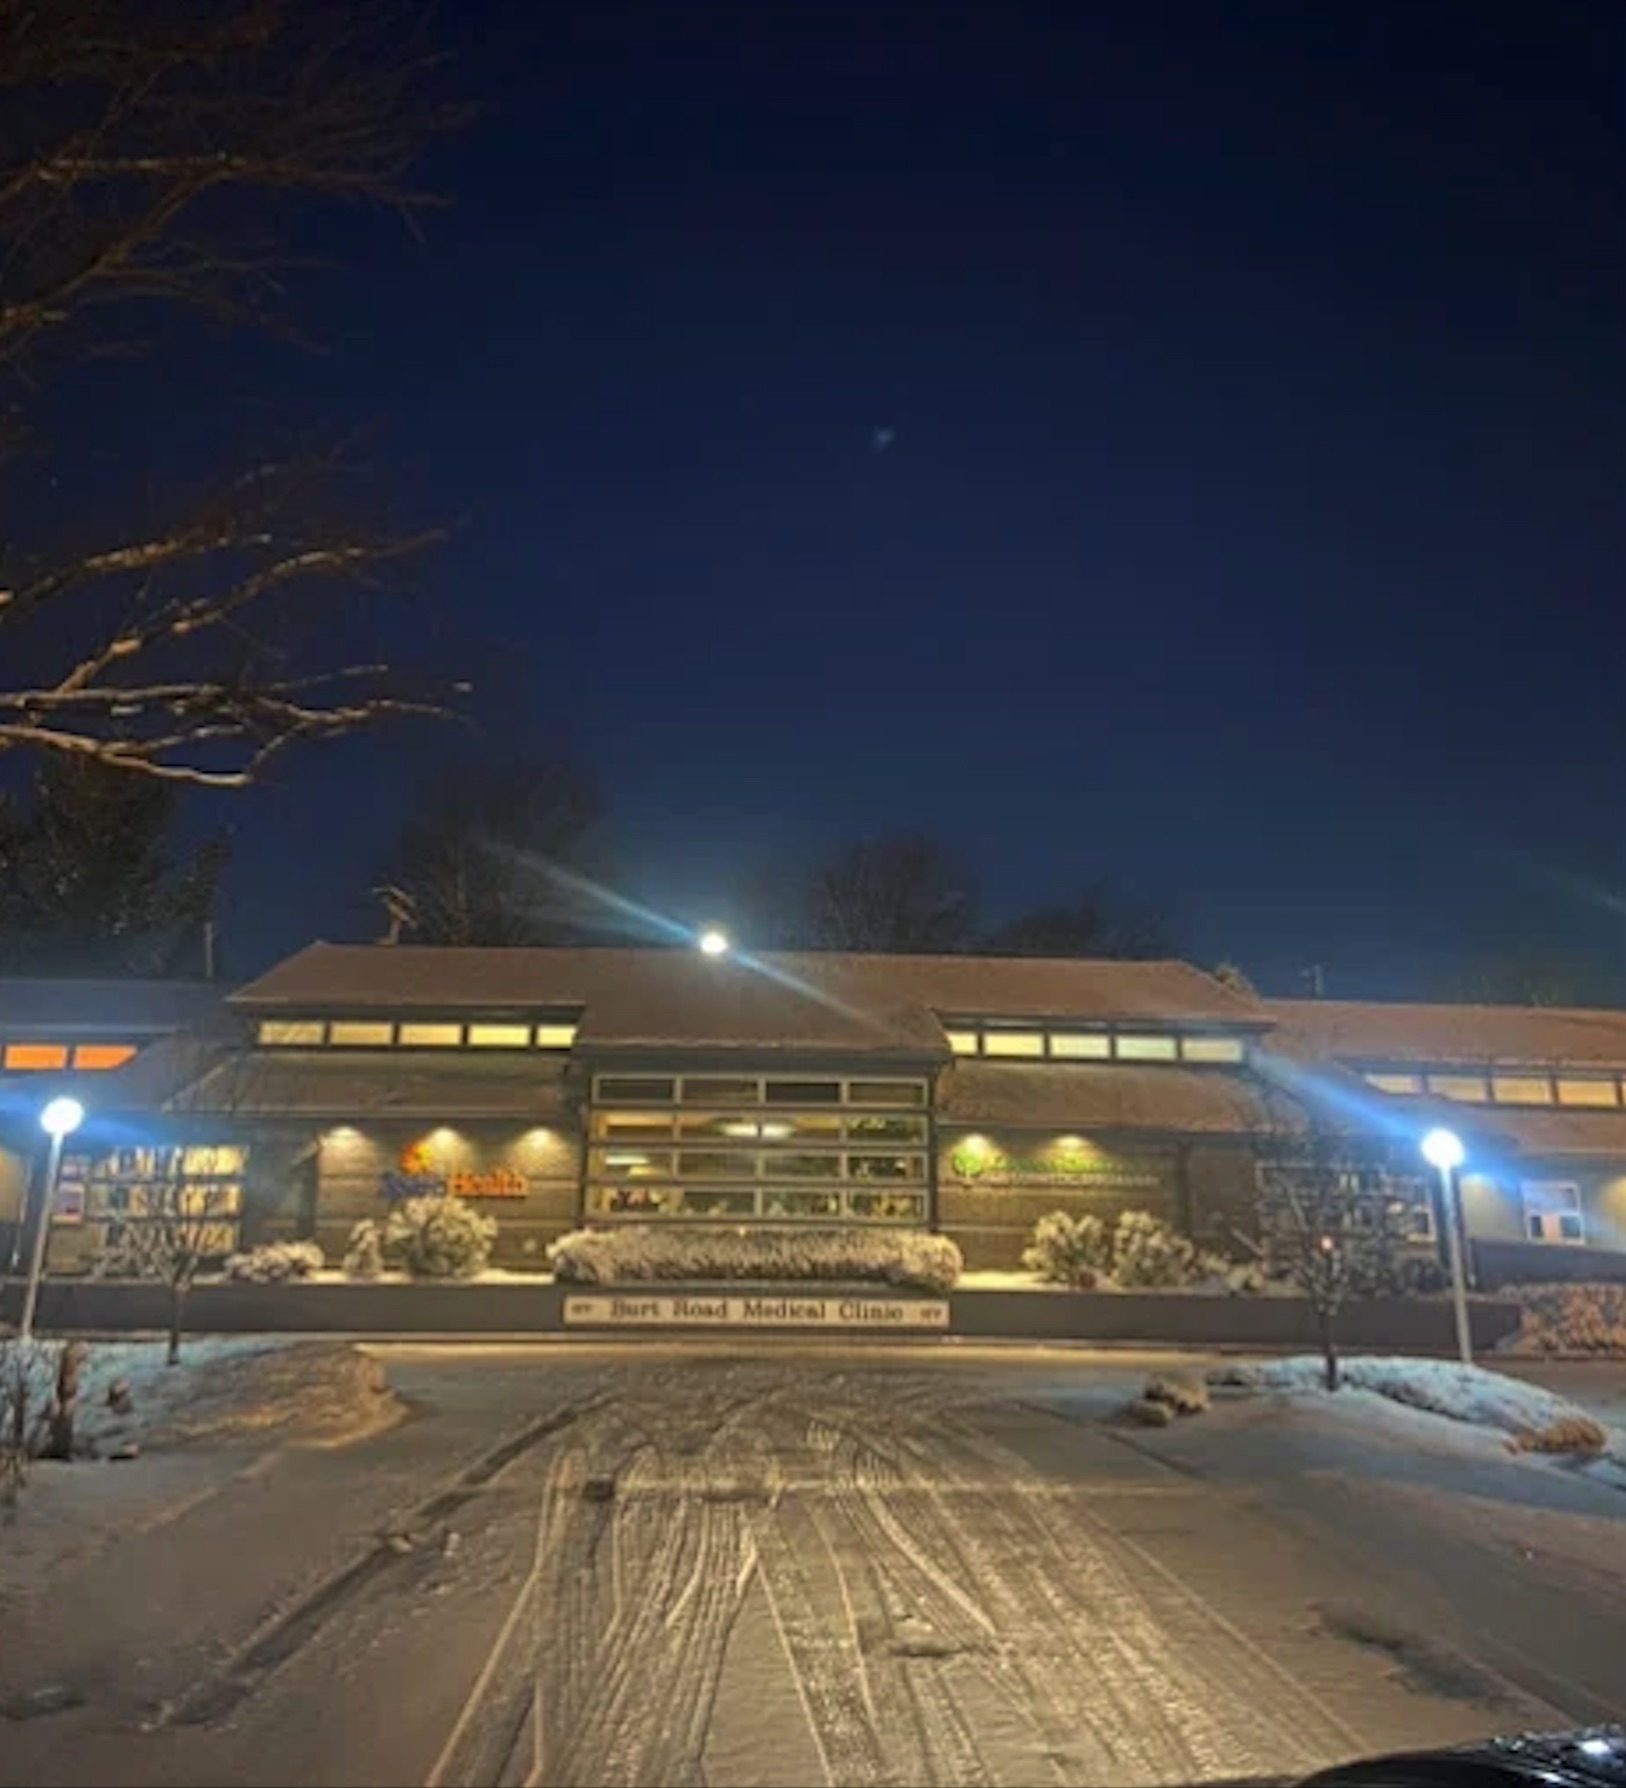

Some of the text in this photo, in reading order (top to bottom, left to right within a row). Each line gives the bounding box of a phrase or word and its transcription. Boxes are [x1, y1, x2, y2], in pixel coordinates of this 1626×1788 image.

[610, 1300, 903, 1320] Burt Road Medical Clinic
